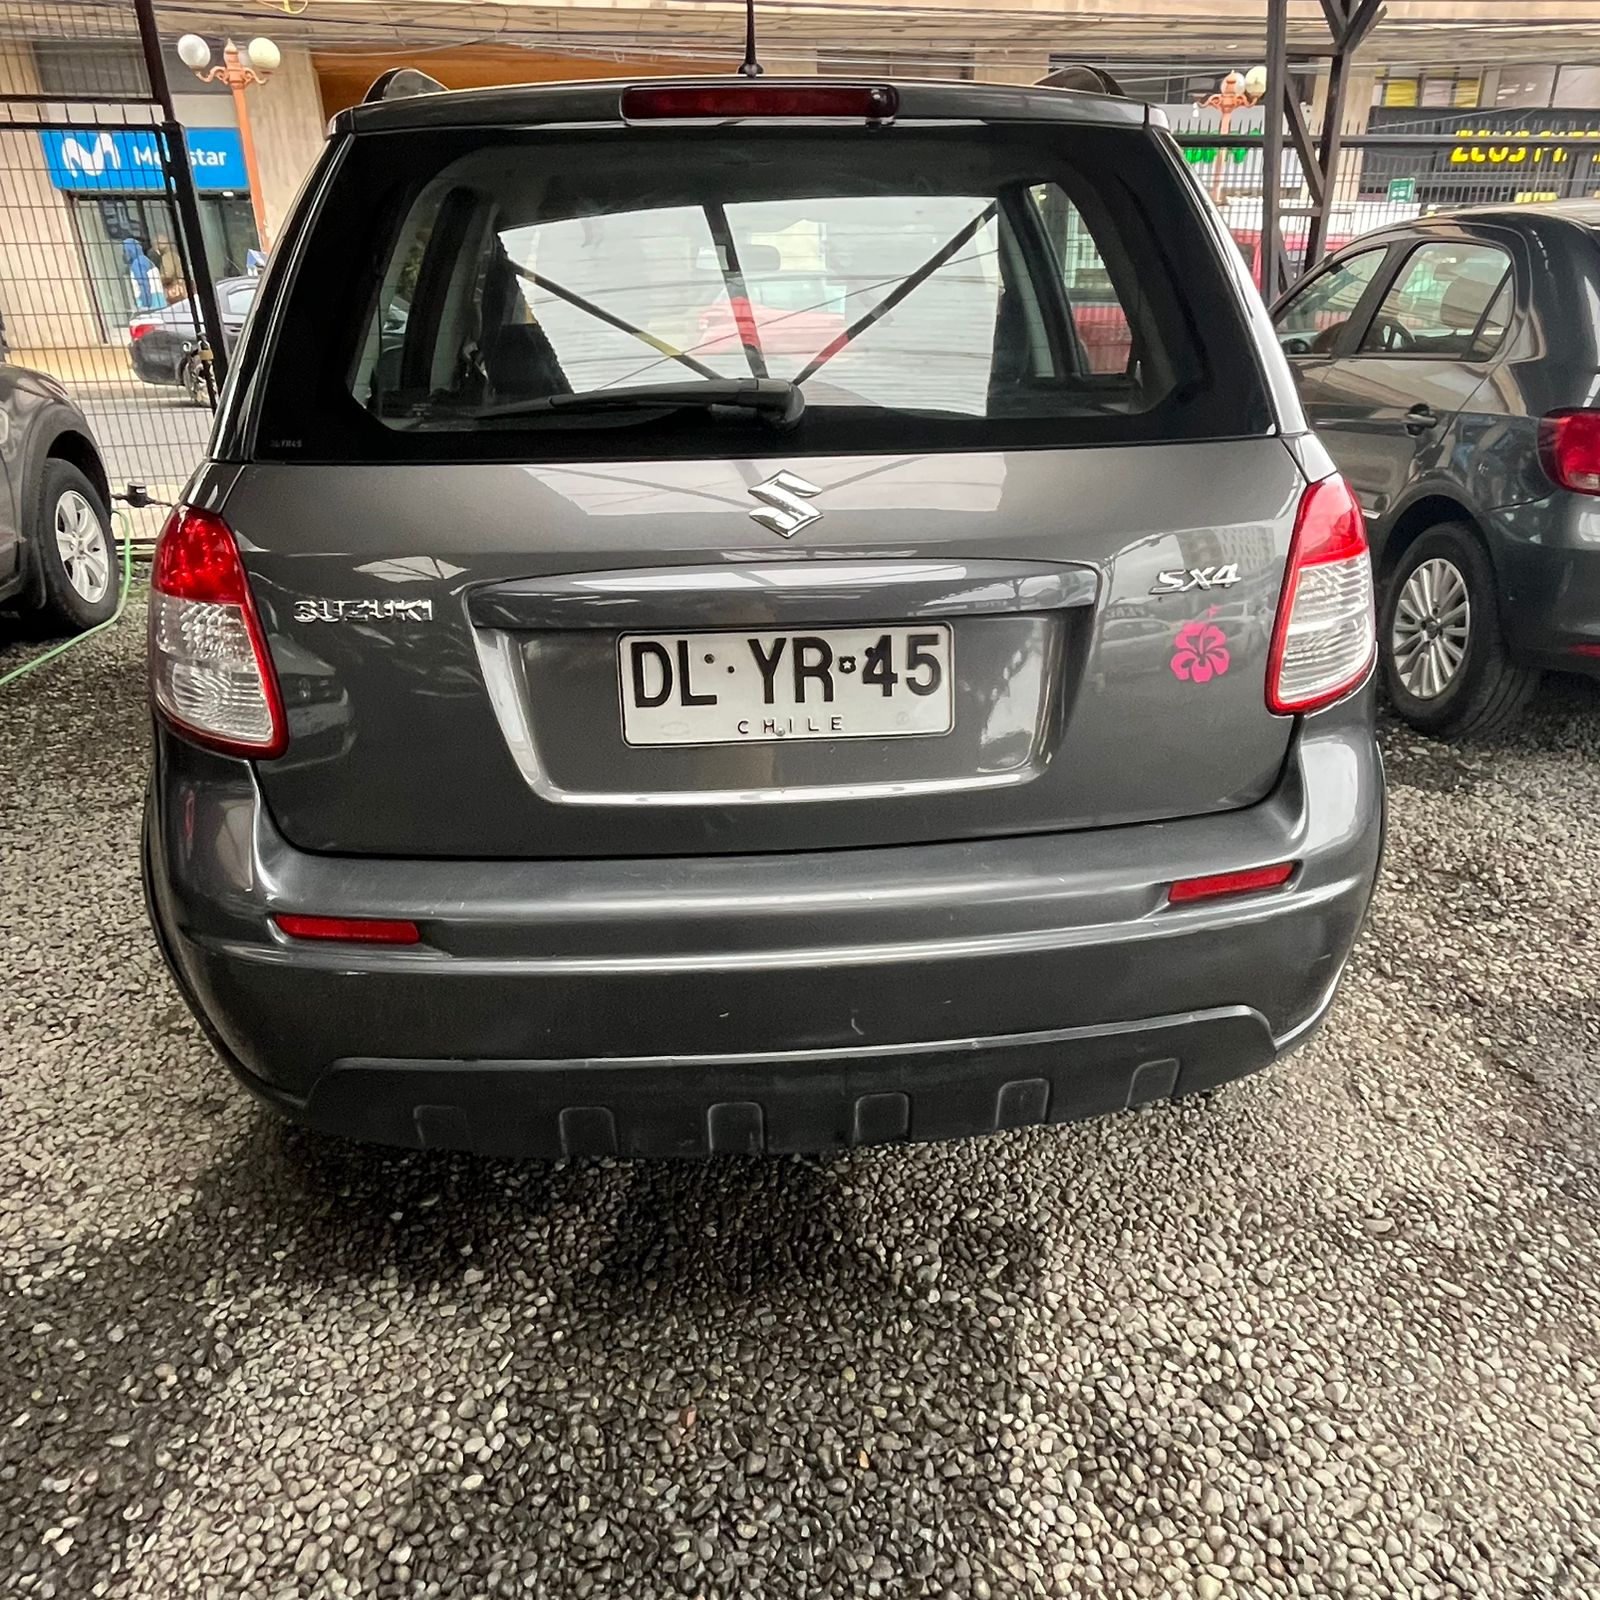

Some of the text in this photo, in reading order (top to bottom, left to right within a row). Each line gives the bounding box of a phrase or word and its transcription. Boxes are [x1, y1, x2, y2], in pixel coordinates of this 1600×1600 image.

[132, 146, 227, 166] Mostar
[1149, 563, 1242, 595] SX4
[294, 599, 433, 622] SUZUKI
[737, 716, 844, 735] CHILE
